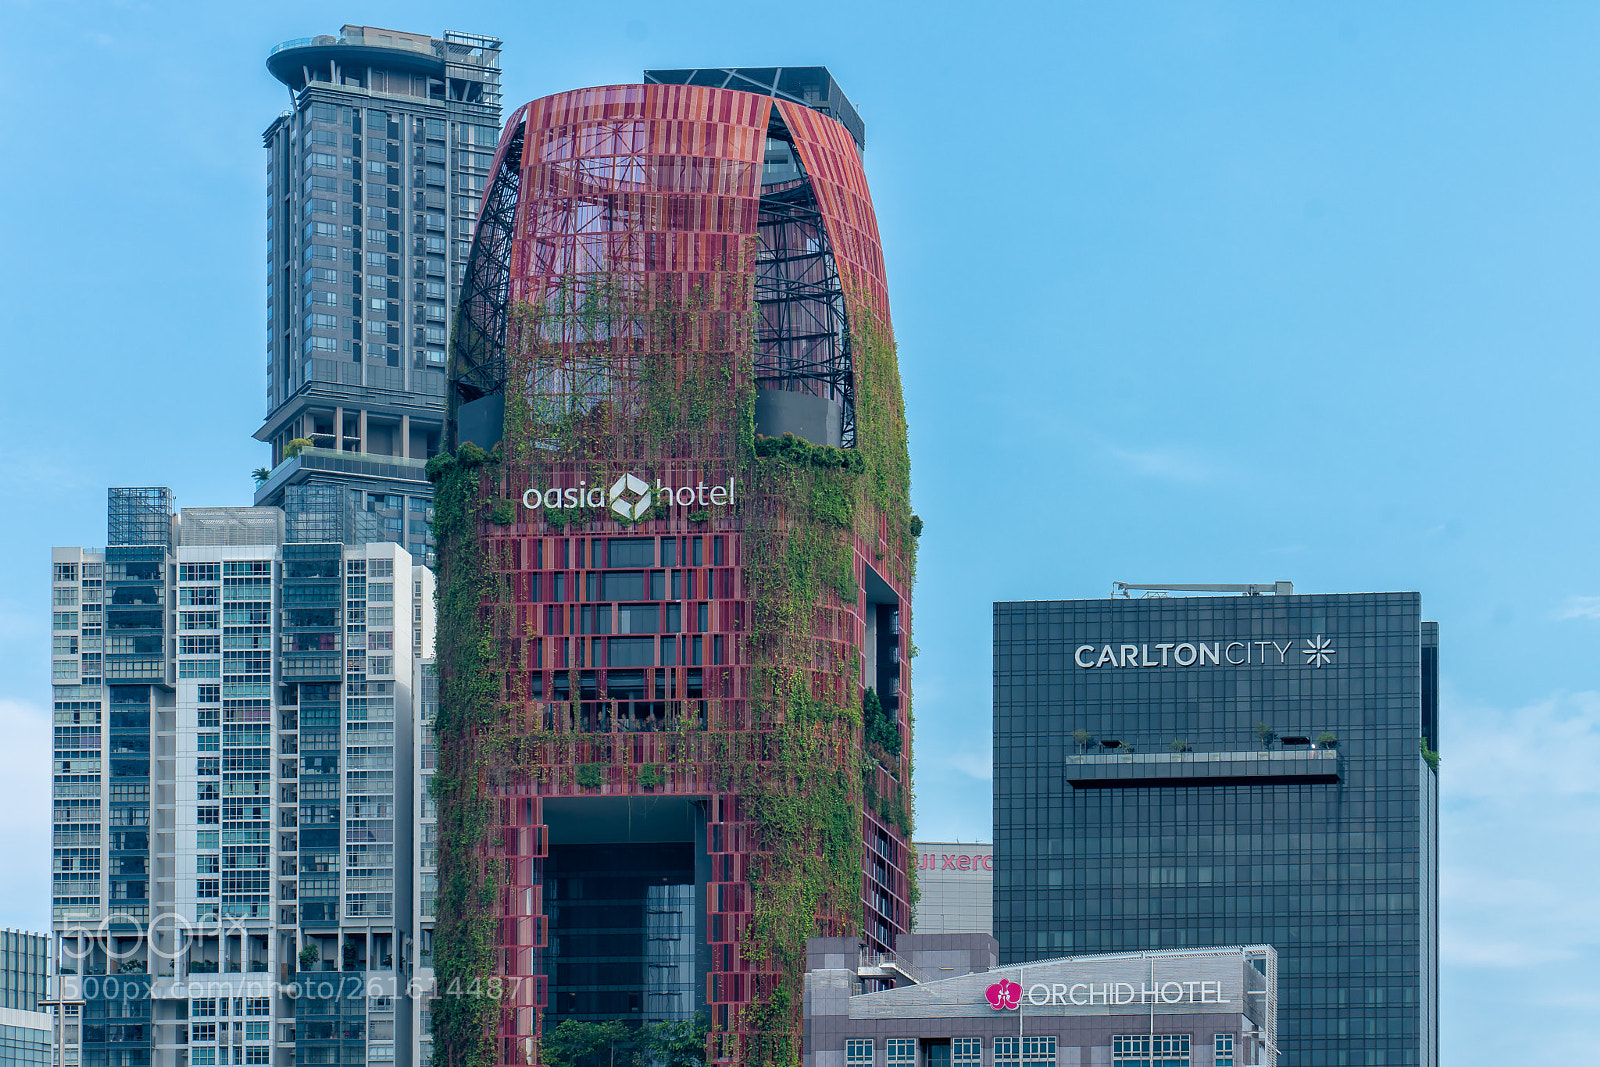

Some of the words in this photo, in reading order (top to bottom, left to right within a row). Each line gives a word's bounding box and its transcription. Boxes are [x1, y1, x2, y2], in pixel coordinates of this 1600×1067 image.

[522, 480, 605, 510] oasia
[656, 477, 735, 506] hotel
[914, 853, 936, 871] JI
[1028, 982, 1135, 1006] ORCHID
[1141, 980, 1231, 1005] HOTEL
